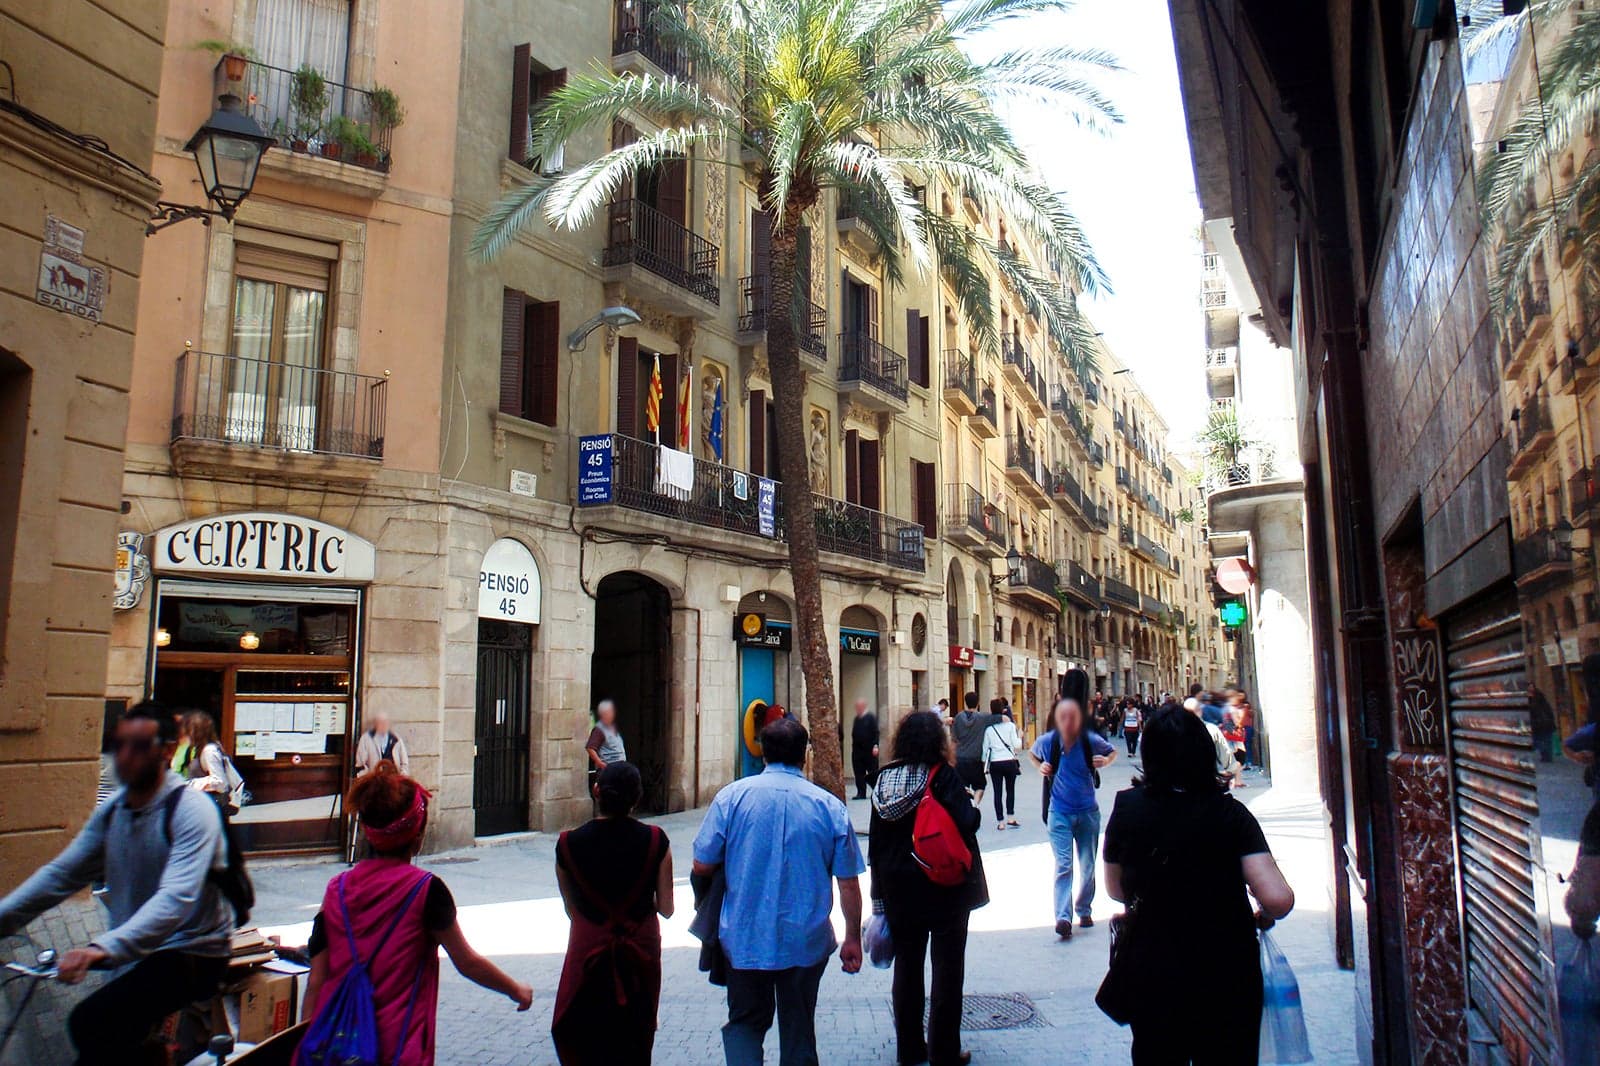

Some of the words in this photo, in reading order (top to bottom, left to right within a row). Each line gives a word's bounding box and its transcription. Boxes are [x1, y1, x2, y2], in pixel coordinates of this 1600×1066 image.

[41, 293, 98, 319] SALIDA
[581, 437, 610, 451] PENSIÓ
[588, 453, 602, 466] 45
[168, 520, 344, 573] CENTRIC
[479, 572, 529, 595] PENSIÓ
[499, 598, 516, 616] 45
